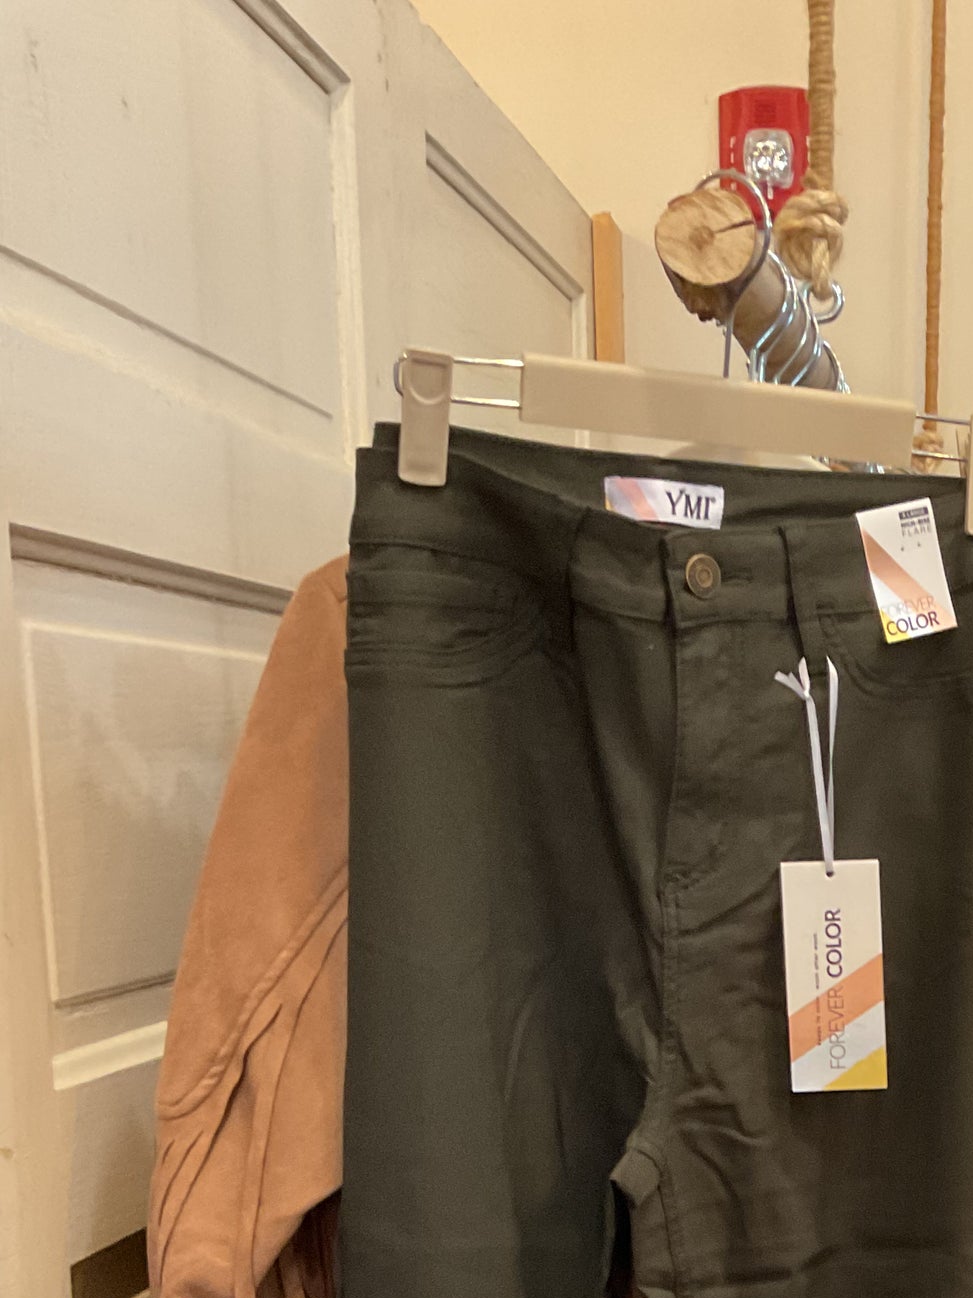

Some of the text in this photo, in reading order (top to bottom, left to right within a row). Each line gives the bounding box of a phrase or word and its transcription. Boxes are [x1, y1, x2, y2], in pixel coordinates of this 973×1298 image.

[665, 488, 712, 520] YMI
[881, 595, 936, 616] FOREVER
[886, 611, 940, 635] COLOR
[824, 908, 847, 1069] FOREVER COLOR
